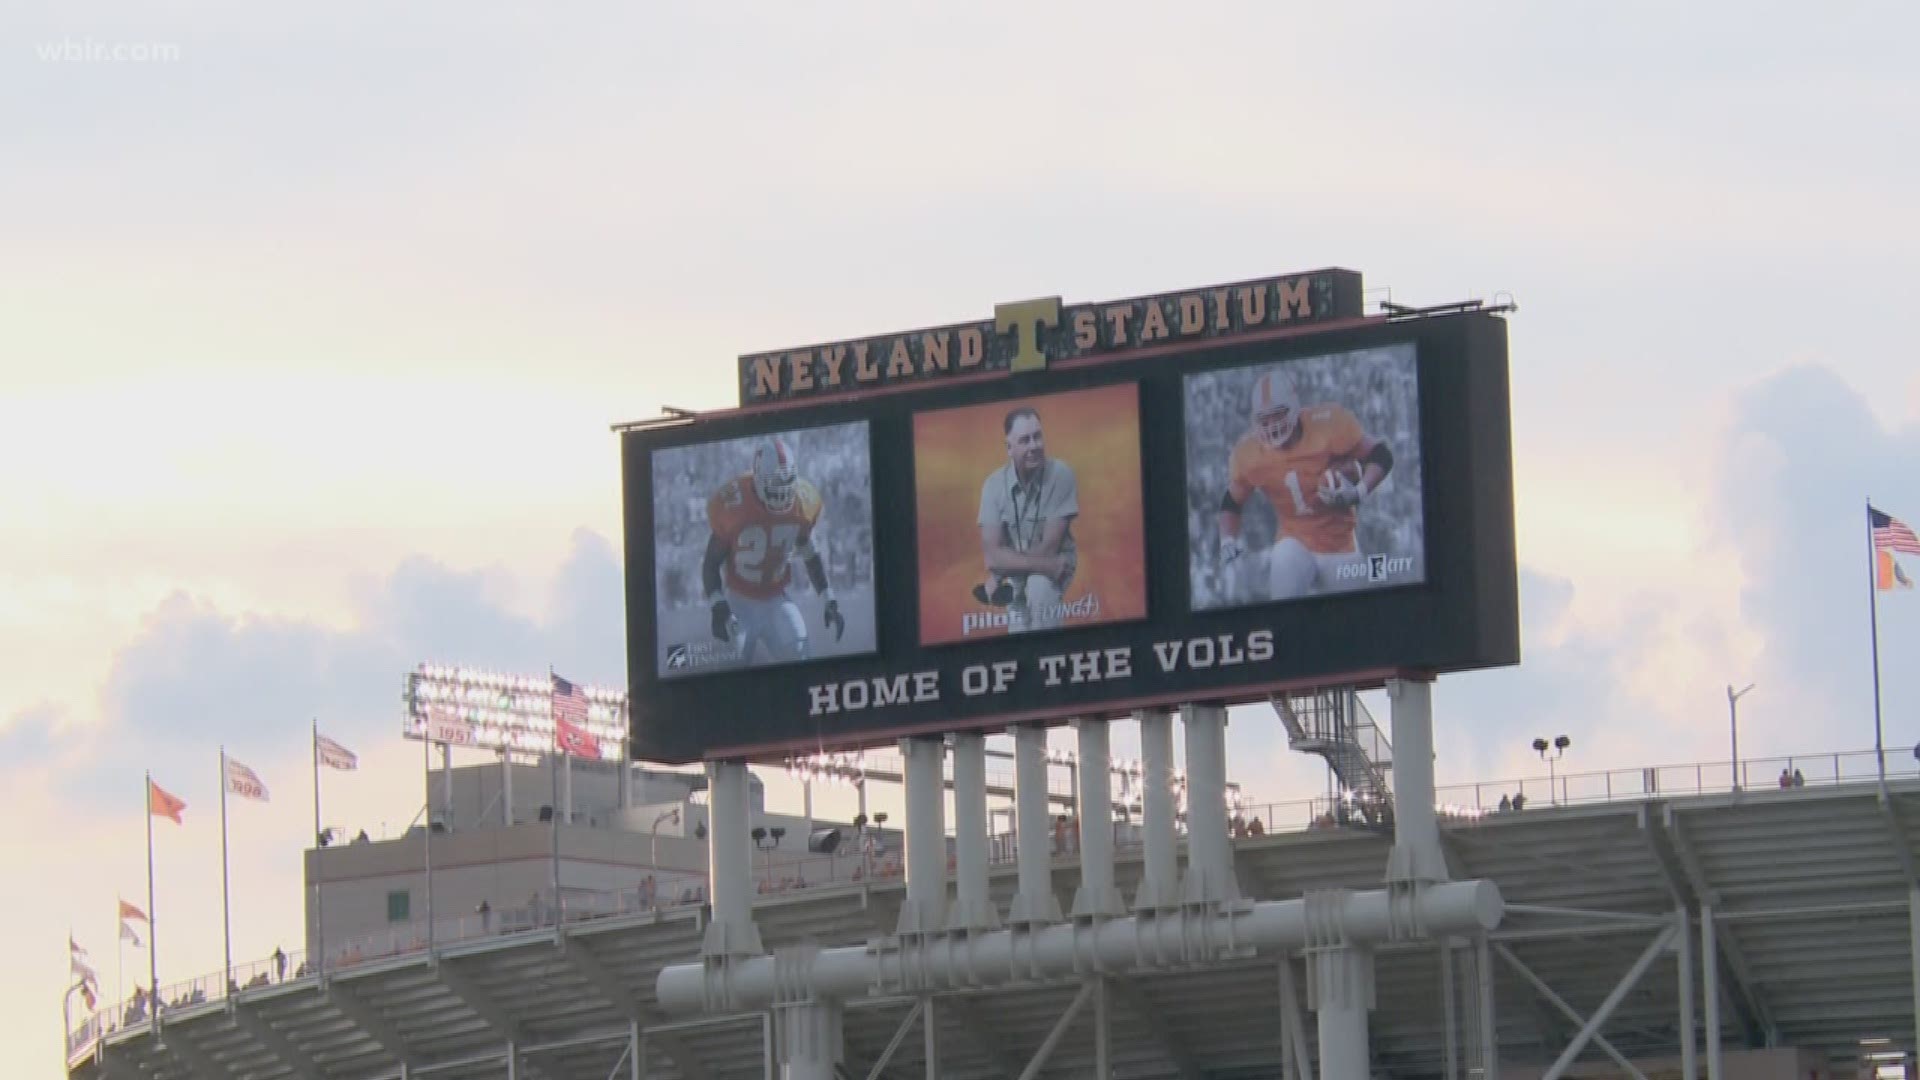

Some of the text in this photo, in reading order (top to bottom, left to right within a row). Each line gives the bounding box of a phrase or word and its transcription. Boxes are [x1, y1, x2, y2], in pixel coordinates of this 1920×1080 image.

[751, 276, 1312, 397] NEYLAND T STADIUM
[734, 524, 799, 583] 27
[1336, 563, 1367, 579] FOOD
[1387, 557, 1413, 573] CITY
[808, 629, 1275, 717] HOME OF THE VOLS
